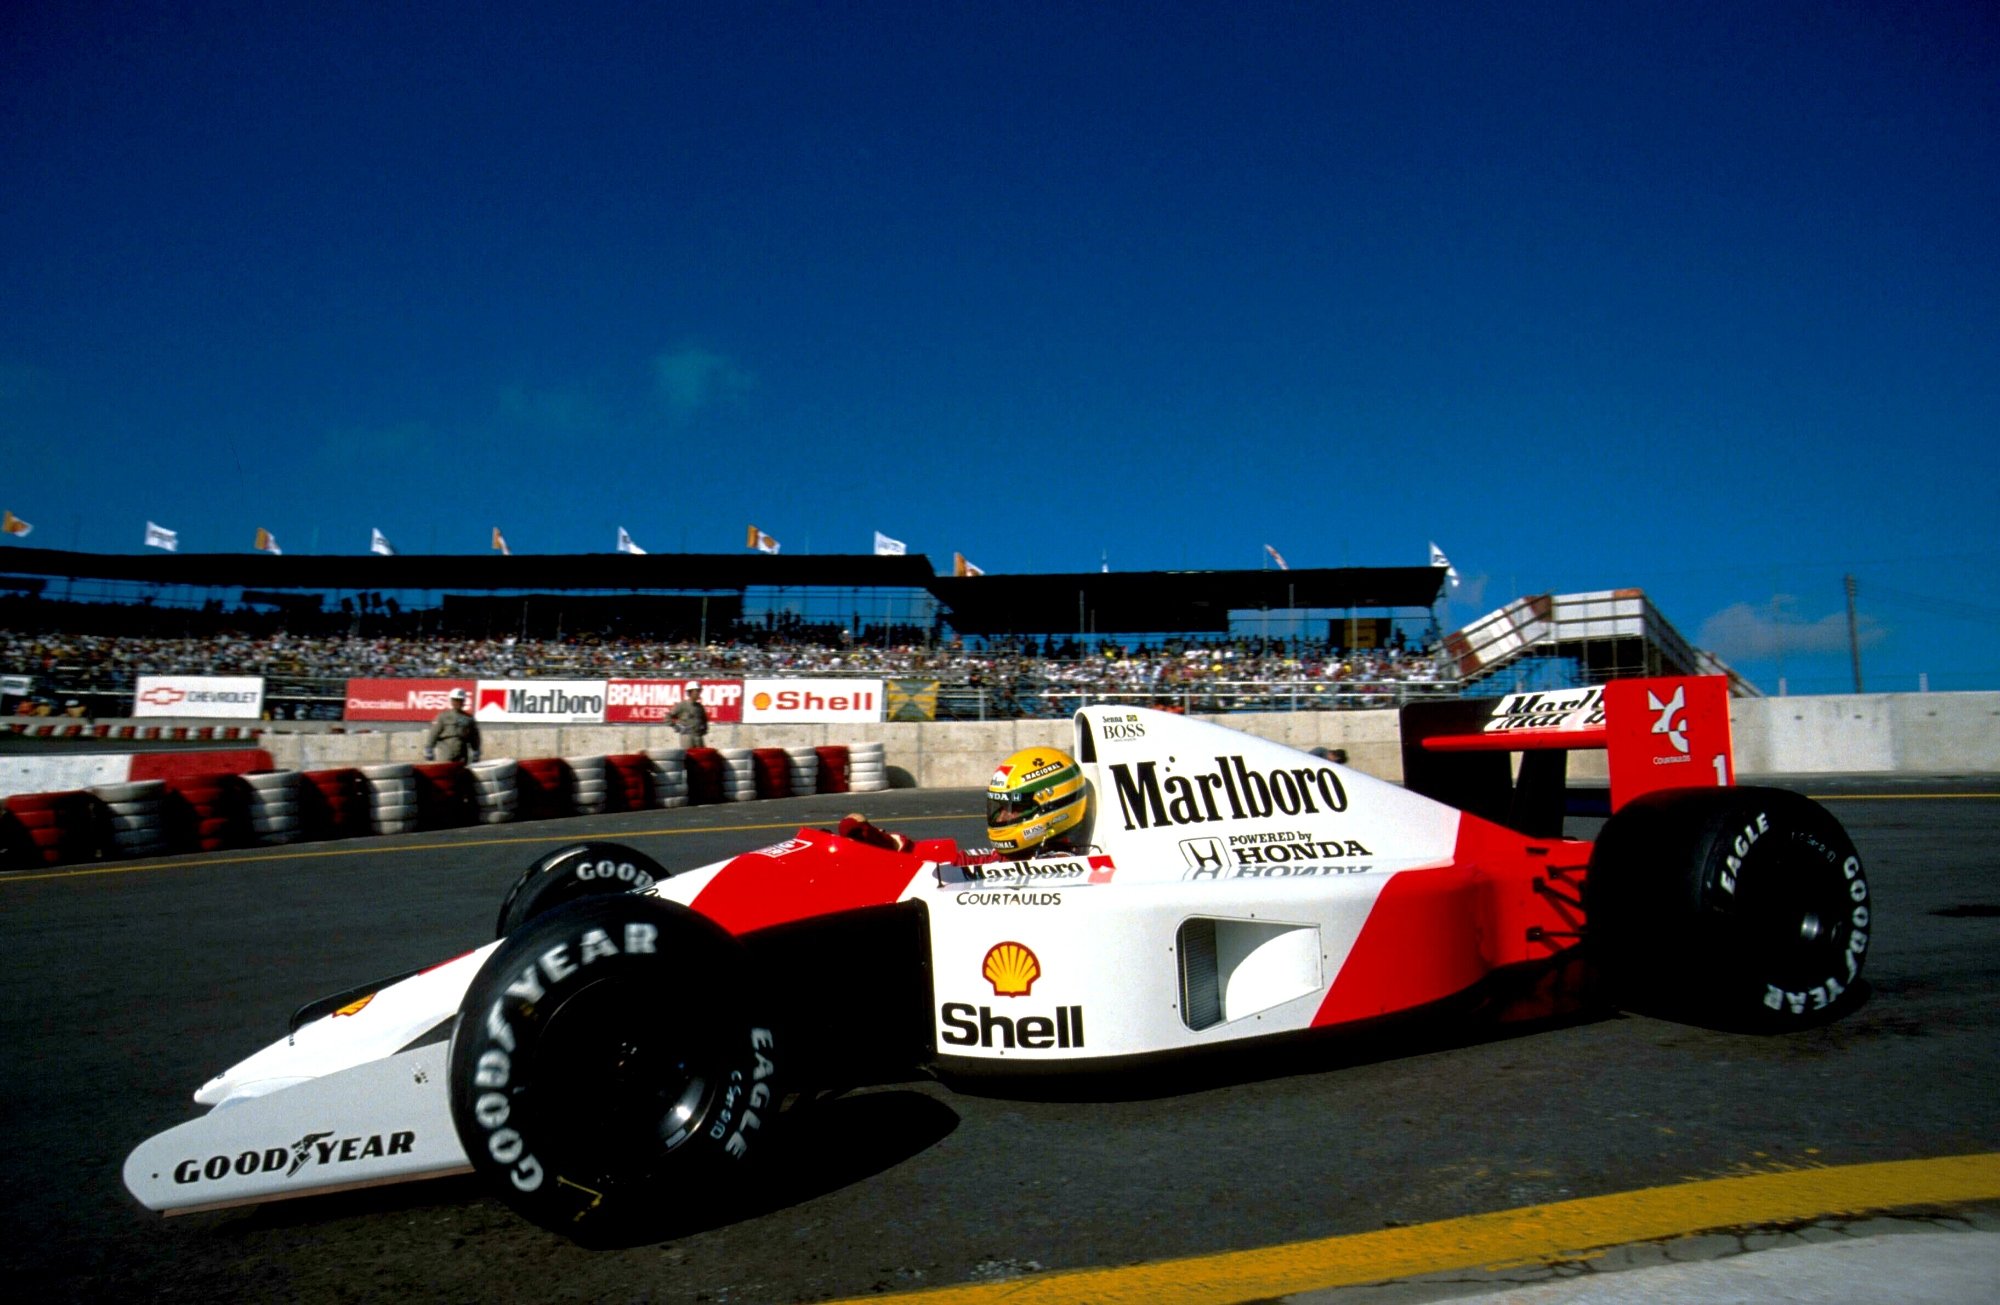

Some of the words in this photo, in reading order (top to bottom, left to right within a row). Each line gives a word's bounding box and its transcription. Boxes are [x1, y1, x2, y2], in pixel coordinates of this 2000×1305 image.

[187, 691, 258, 704] CHEVROLET
[508, 689, 602, 714] Marlboro
[607, 684, 681, 706] BRAHMA
[776, 691, 872, 711] Shell
[1102, 715, 1123, 723] Senna
[1103, 723, 1146, 739] BOSS
[1025, 763, 1060, 781] NACIONAL
[1712, 754, 1727, 787] 1
[1109, 755, 1348, 830] Marlboro
[1229, 832, 1295, 846] POWERED
[1297, 831, 1312, 843] by
[1231, 840, 1373, 865] HONDA
[1720, 812, 1769, 895] EAGLE
[576, 860, 655, 889] GOOD
[962, 861, 1084, 881] Marlboro
[956, 892, 1061, 906] COURTAULDS
[941, 1002, 1085, 1049] Shell
[725, 1027, 774, 1160] EAGLE
